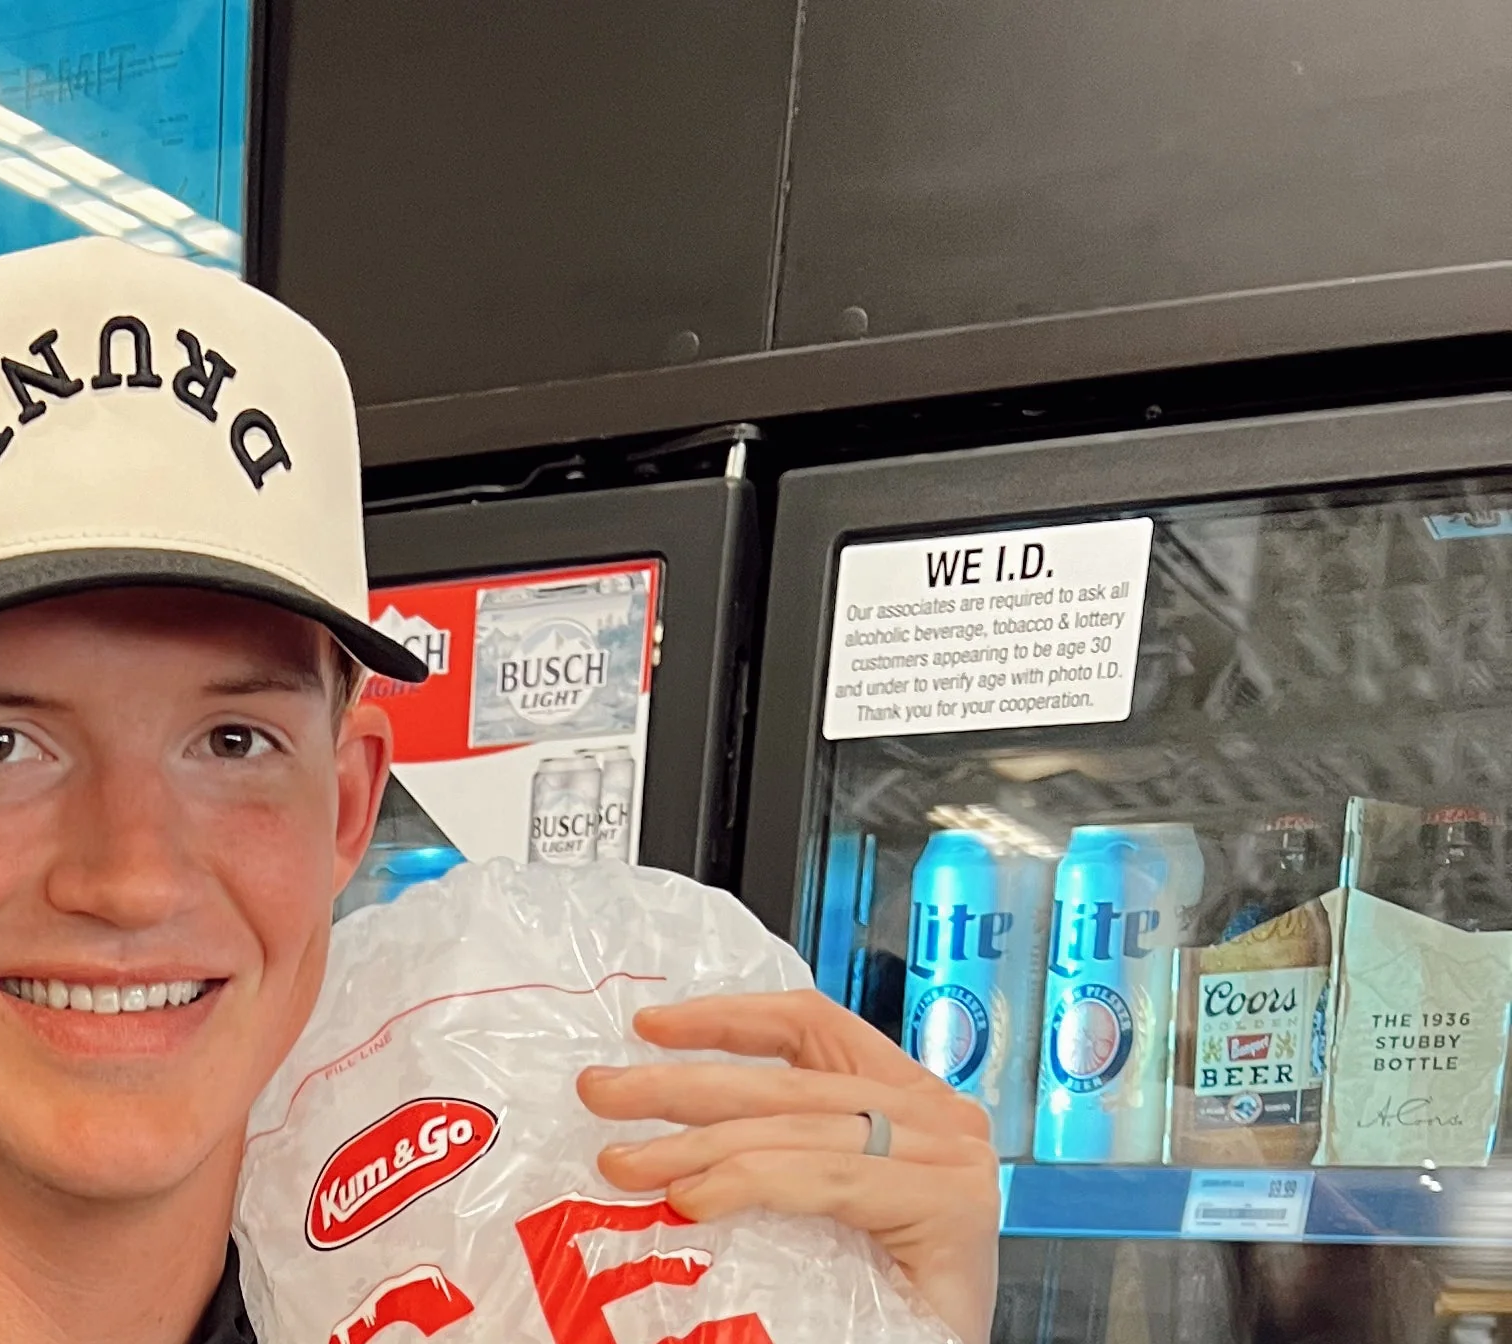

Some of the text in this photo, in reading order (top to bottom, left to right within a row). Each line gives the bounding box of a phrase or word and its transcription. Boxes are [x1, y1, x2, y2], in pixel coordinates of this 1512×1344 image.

[927, 543, 1054, 588] WE I.D.
[846, 581, 1130, 622] Our associates are required to ask all
[845, 609, 1126, 648] alcoholic beverage, tobacco & lottery
[499, 651, 605, 694] BUSCH
[851, 635, 1112, 672] customers appearing to be age 30
[519, 688, 583, 710] LIGHT
[834, 661, 1123, 699] and under to verify age with photo I.D.
[856, 691, 1094, 723] Thank you for your cooperation.
[532, 812, 598, 841] BUSCH
[540, 838, 585, 854] LIGHT
[909, 901, 1013, 980] Lite
[1048, 899, 1161, 979] Lite
[1204, 980, 1298, 1018] Coors
[1372, 1012, 1471, 1028] THE 1936
[325, 1029, 393, 1081] FILL LINE
[1375, 1034, 1462, 1049] STUBBY
[1200, 1063, 1294, 1089] BEER
[1374, 1057, 1459, 1072] BOTTLE
[319, 1114, 474, 1231] Kum & Go
